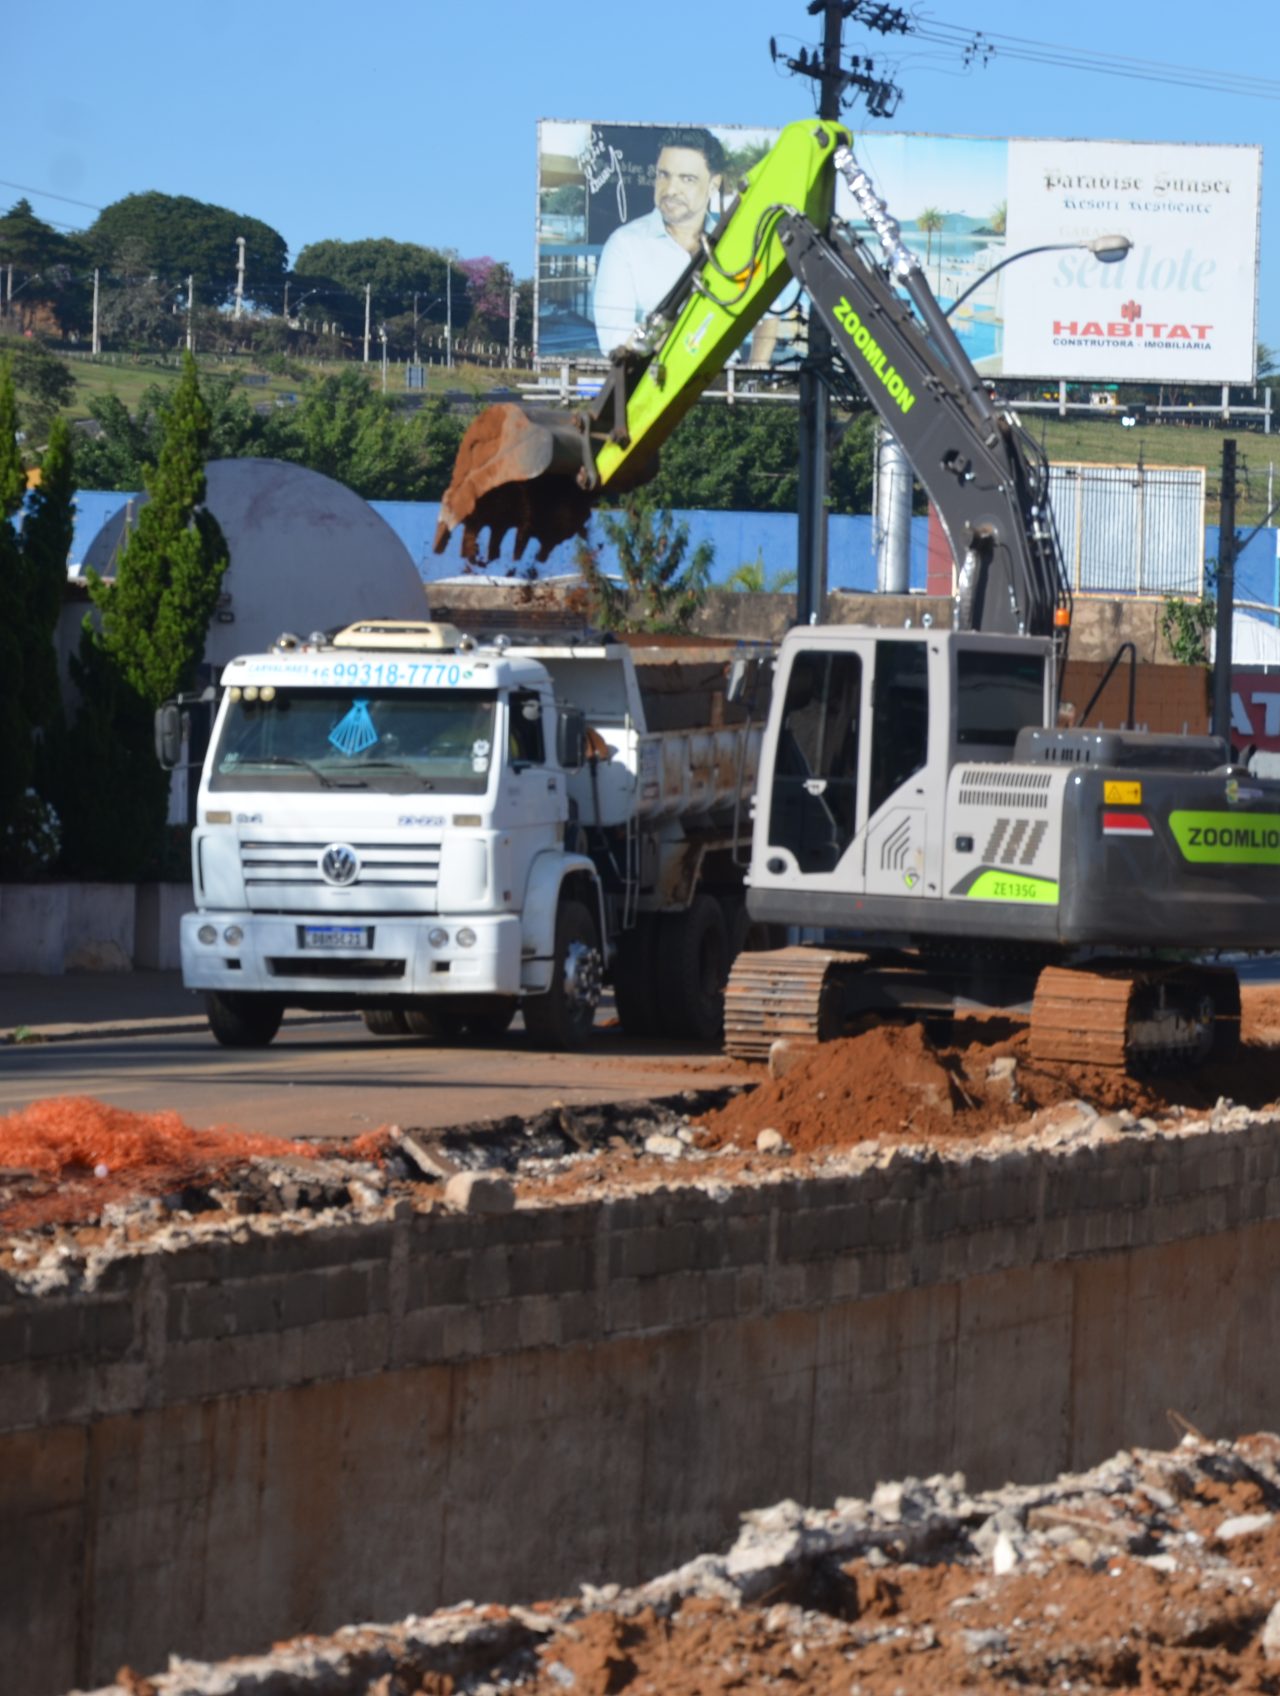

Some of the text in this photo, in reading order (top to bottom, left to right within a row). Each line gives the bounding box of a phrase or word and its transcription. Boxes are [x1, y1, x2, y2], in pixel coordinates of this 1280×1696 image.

[1136, 244, 1217, 292] lote
[1052, 320, 1214, 340] HABITAT
[1053, 338, 1134, 348] CONSTRUTORA
[832, 295, 916, 414] ZOOMLION
[333, 663, 460, 687] 99318-7770
[993, 881, 1037, 899] ZE135G
